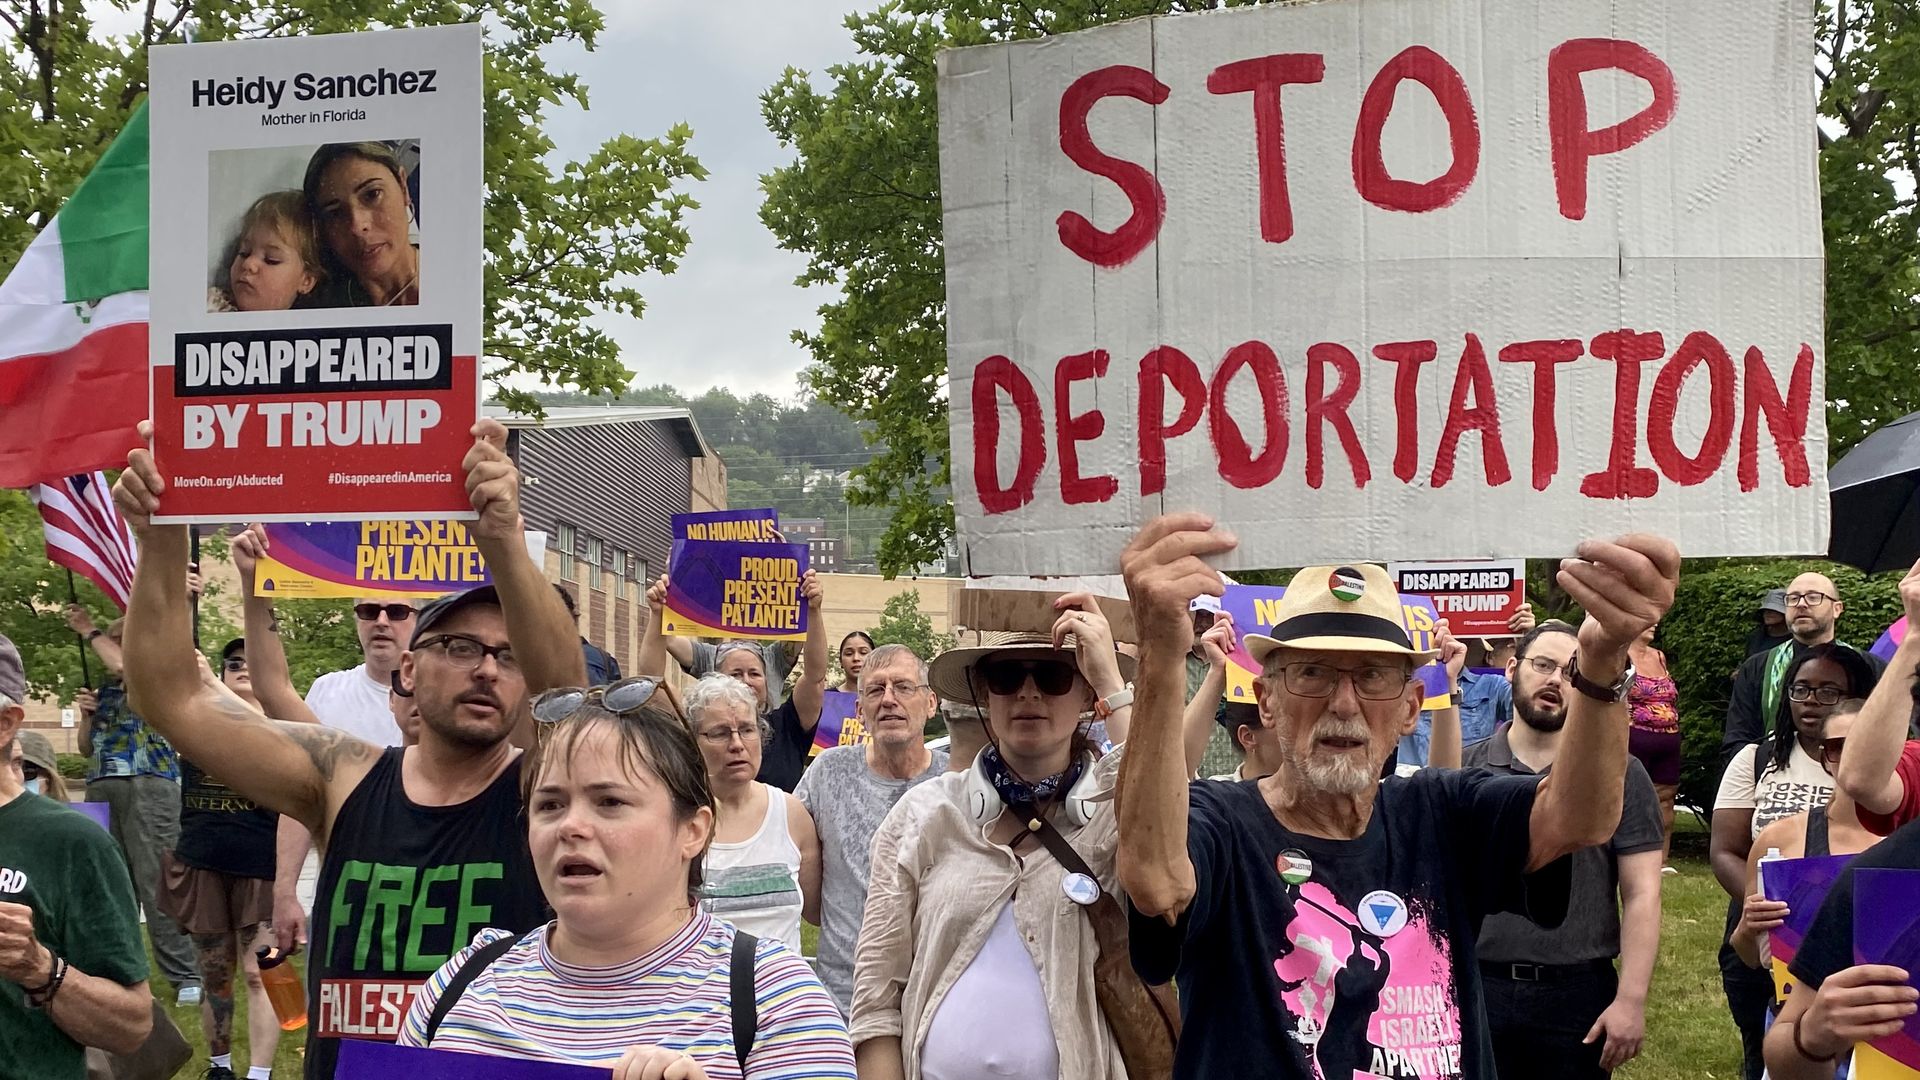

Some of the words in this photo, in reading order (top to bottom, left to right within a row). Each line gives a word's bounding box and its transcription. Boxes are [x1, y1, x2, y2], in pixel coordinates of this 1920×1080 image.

[192, 76, 286, 109] Heidy
[293, 68, 437, 101] Sanchez
[261, 113, 307, 126] Mother
[310, 111, 320, 123] in
[323, 109, 366, 122] Florida
[1056, 38, 1678, 268] STOP
[185, 335, 441, 387] DISAPPEARED
[183, 403, 250, 449] BY
[257, 398, 442, 448] TRUMP
[972, 328, 1812, 516] DEPORTATION
[174, 474, 283, 488] MoveOn.org/Abducted
[328, 471, 452, 486] #DisappearedinAmerica
[361, 520, 476, 545] PRESEN
[687, 524, 706, 540] NO
[708, 520, 759, 540] HUMAN
[761, 519, 775, 539] IS
[740, 556, 801, 582] PROUD.
[1403, 571, 1510, 590] DISAPPEARED
[724, 579, 800, 605] PRESENT.
[1434, 594, 1510, 612] TRUMP
[1253, 599, 1282, 626] N
[1403, 605, 1434, 631] IS
[325, 860, 503, 972] FREE
[318, 983, 424, 1035] PALES
[1382, 984, 1446, 1015] SMASH
[1380, 1010, 1454, 1047] ISRAELI
